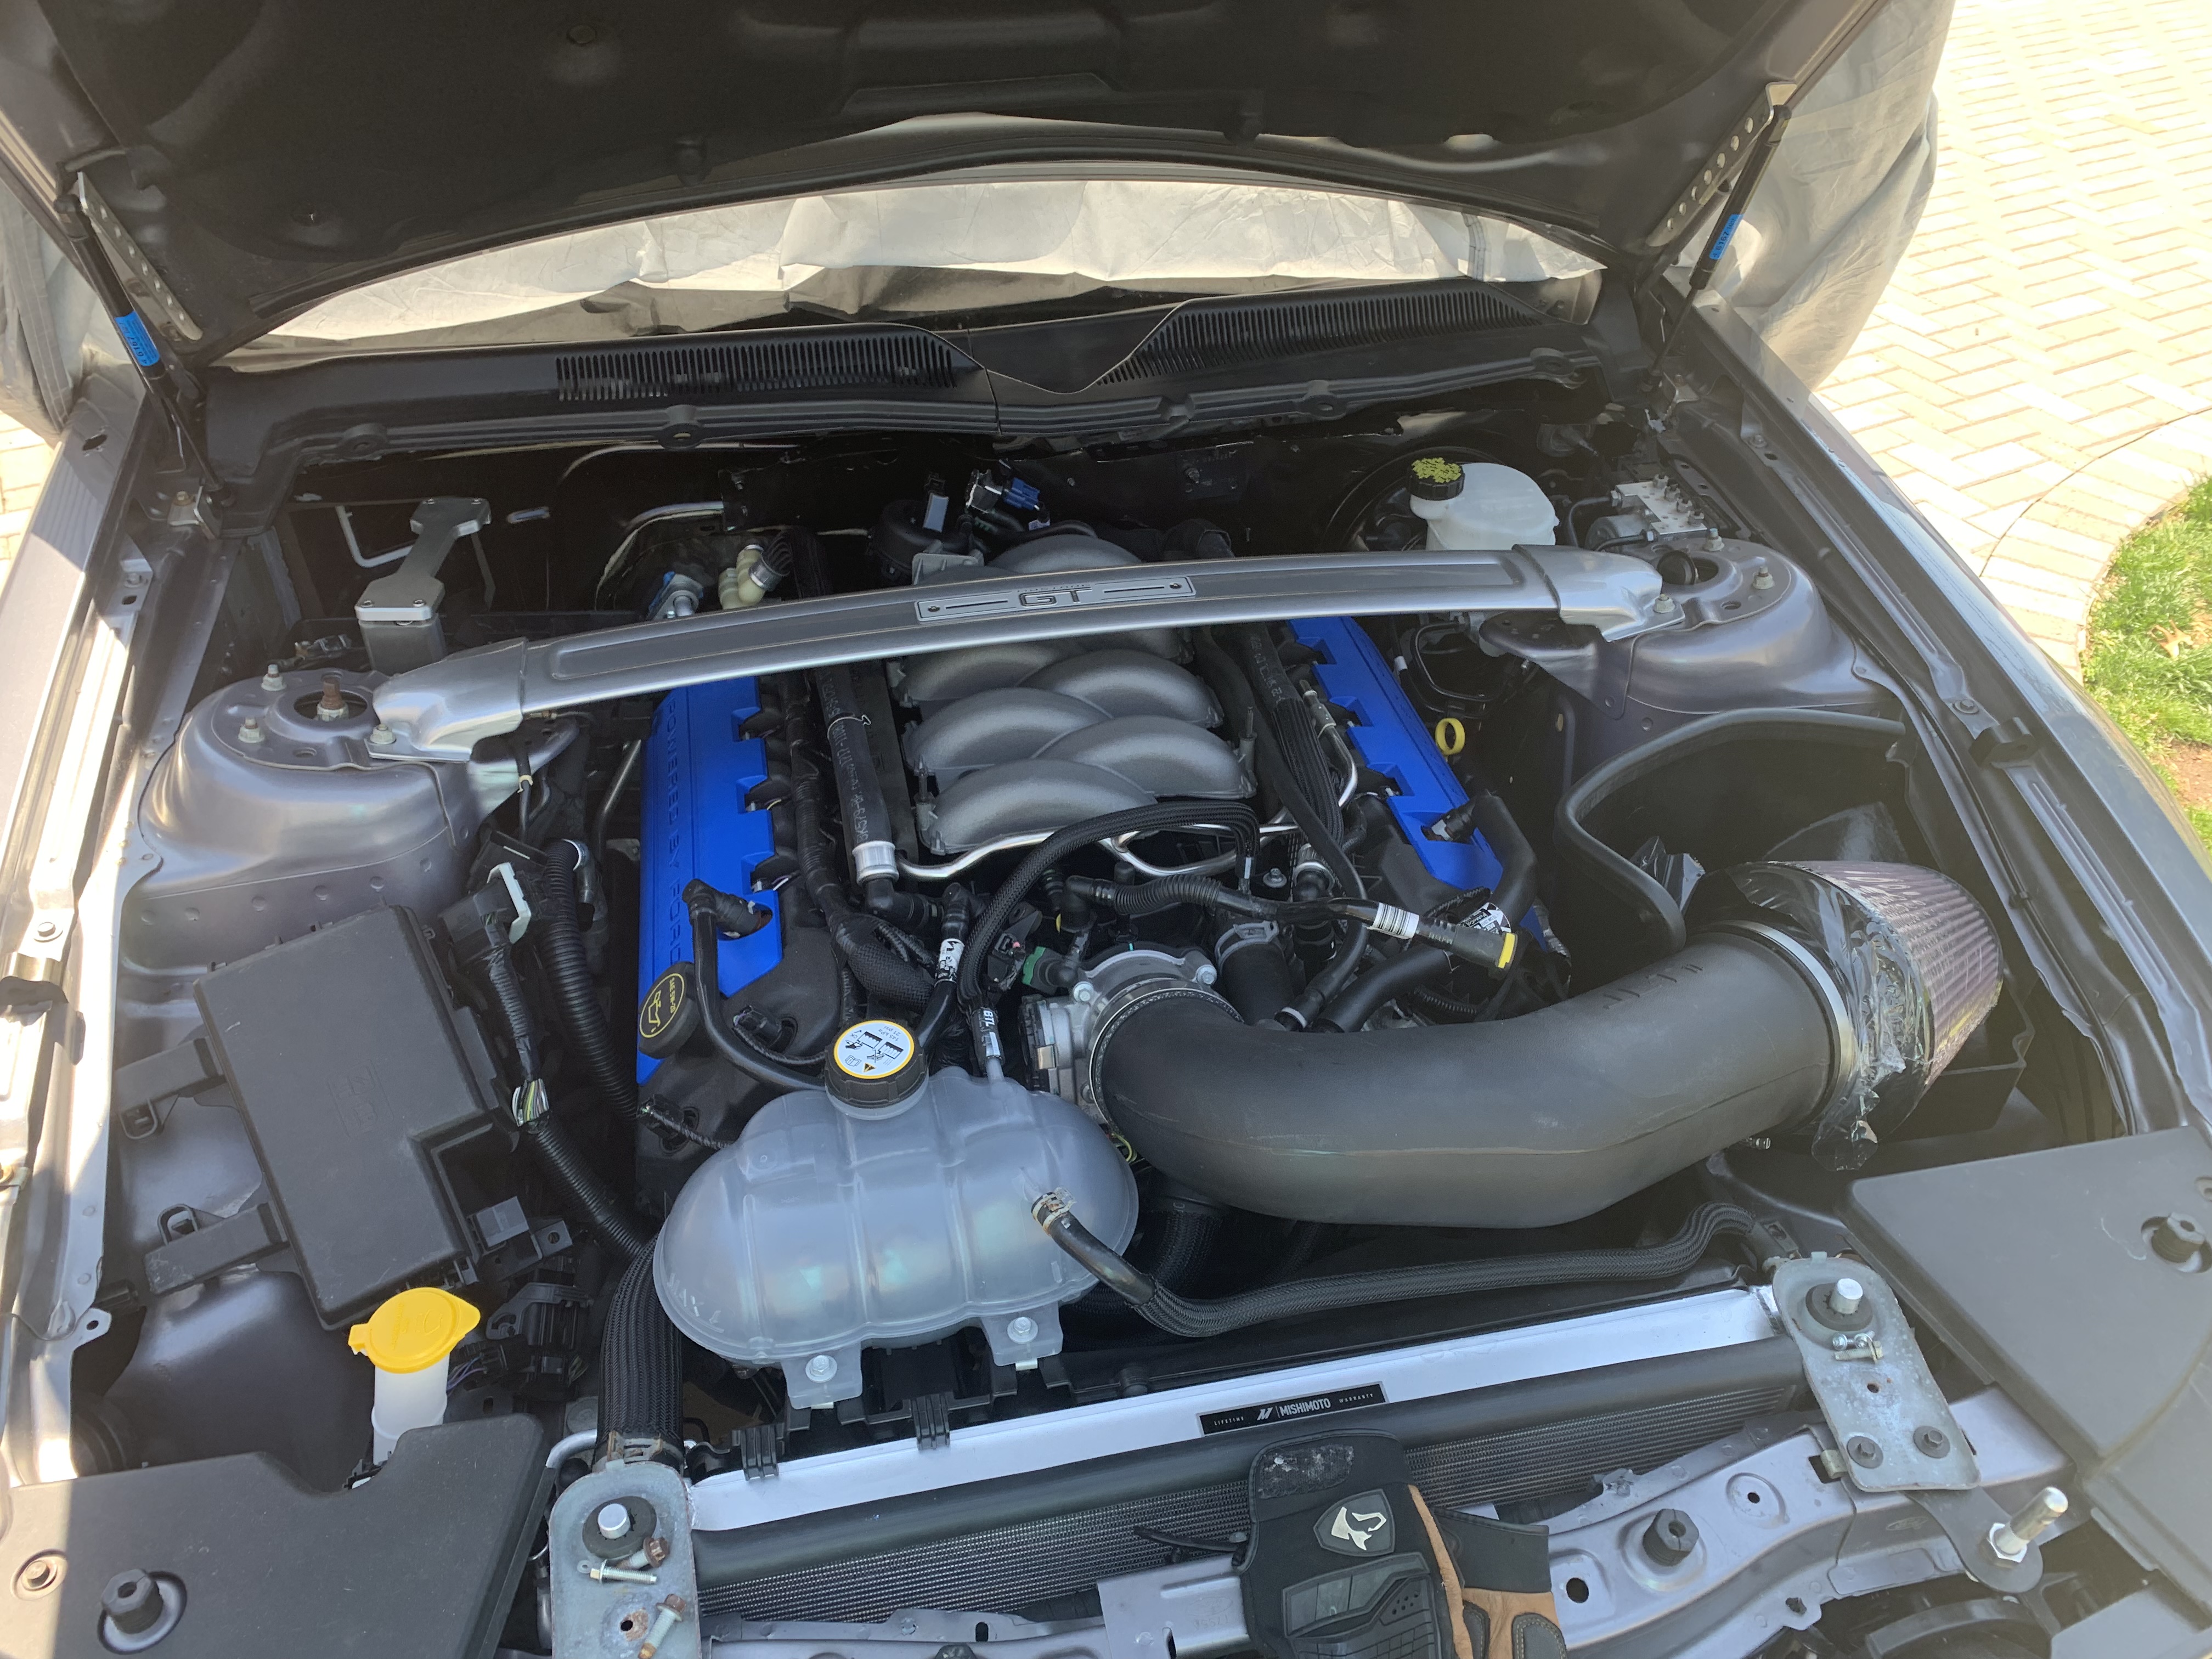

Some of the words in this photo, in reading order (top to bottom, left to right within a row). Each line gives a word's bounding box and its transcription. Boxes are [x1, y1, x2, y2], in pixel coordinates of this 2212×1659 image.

[1018, 586, 1093, 608] GT
[667, 697, 679, 825] POWERED
[669, 828, 679, 868] BY
[669, 878, 681, 966] FORD
[983, 1010, 995, 1027] BTL
[1214, 1416, 1244, 1426] LIFETIME
[1279, 1397, 1331, 1417] MISHIMOTO
[1339, 1393, 1374, 1404] WARRANTY
